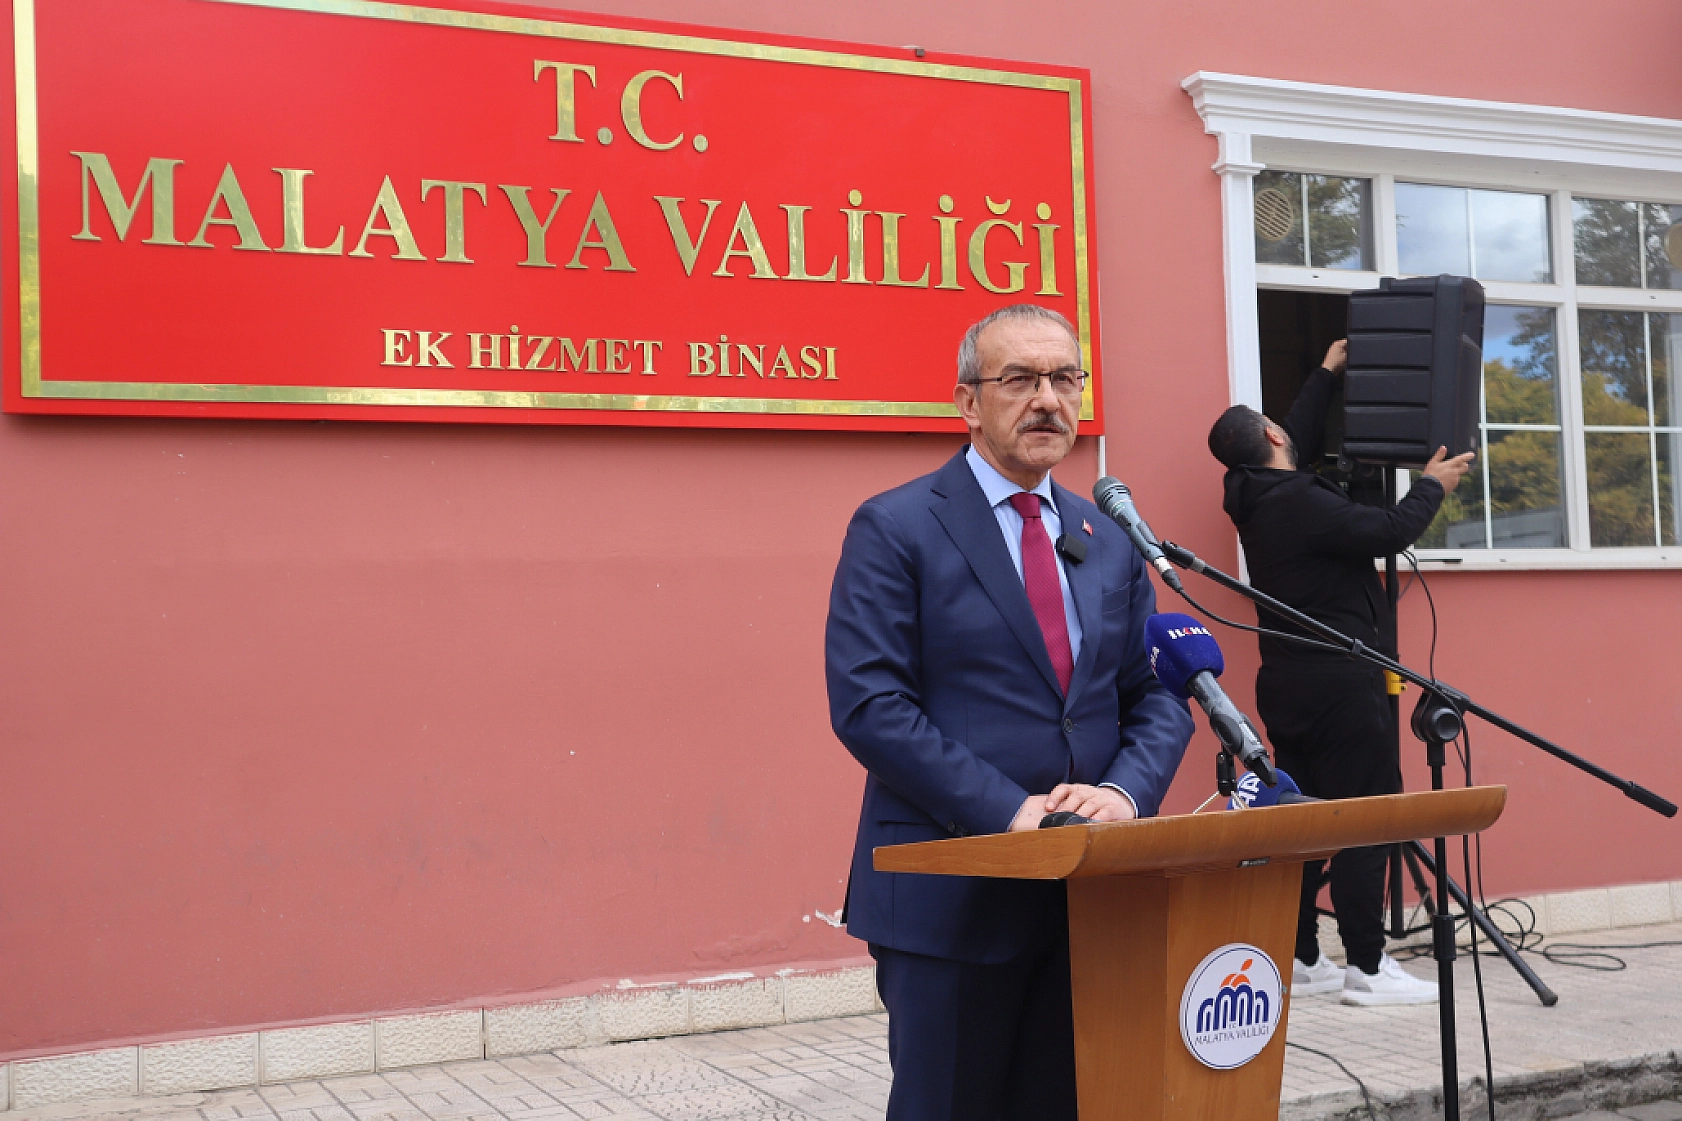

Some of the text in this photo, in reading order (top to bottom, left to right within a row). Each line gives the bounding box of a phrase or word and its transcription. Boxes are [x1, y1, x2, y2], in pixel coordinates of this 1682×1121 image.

[533, 59, 710, 153] T.C.
[70, 150, 1065, 297] MALATYA VALİLİĞİ
[380, 324, 840, 381] EK HİZMET BİNASI
[1195, 1032, 1235, 1046] MALATYA
